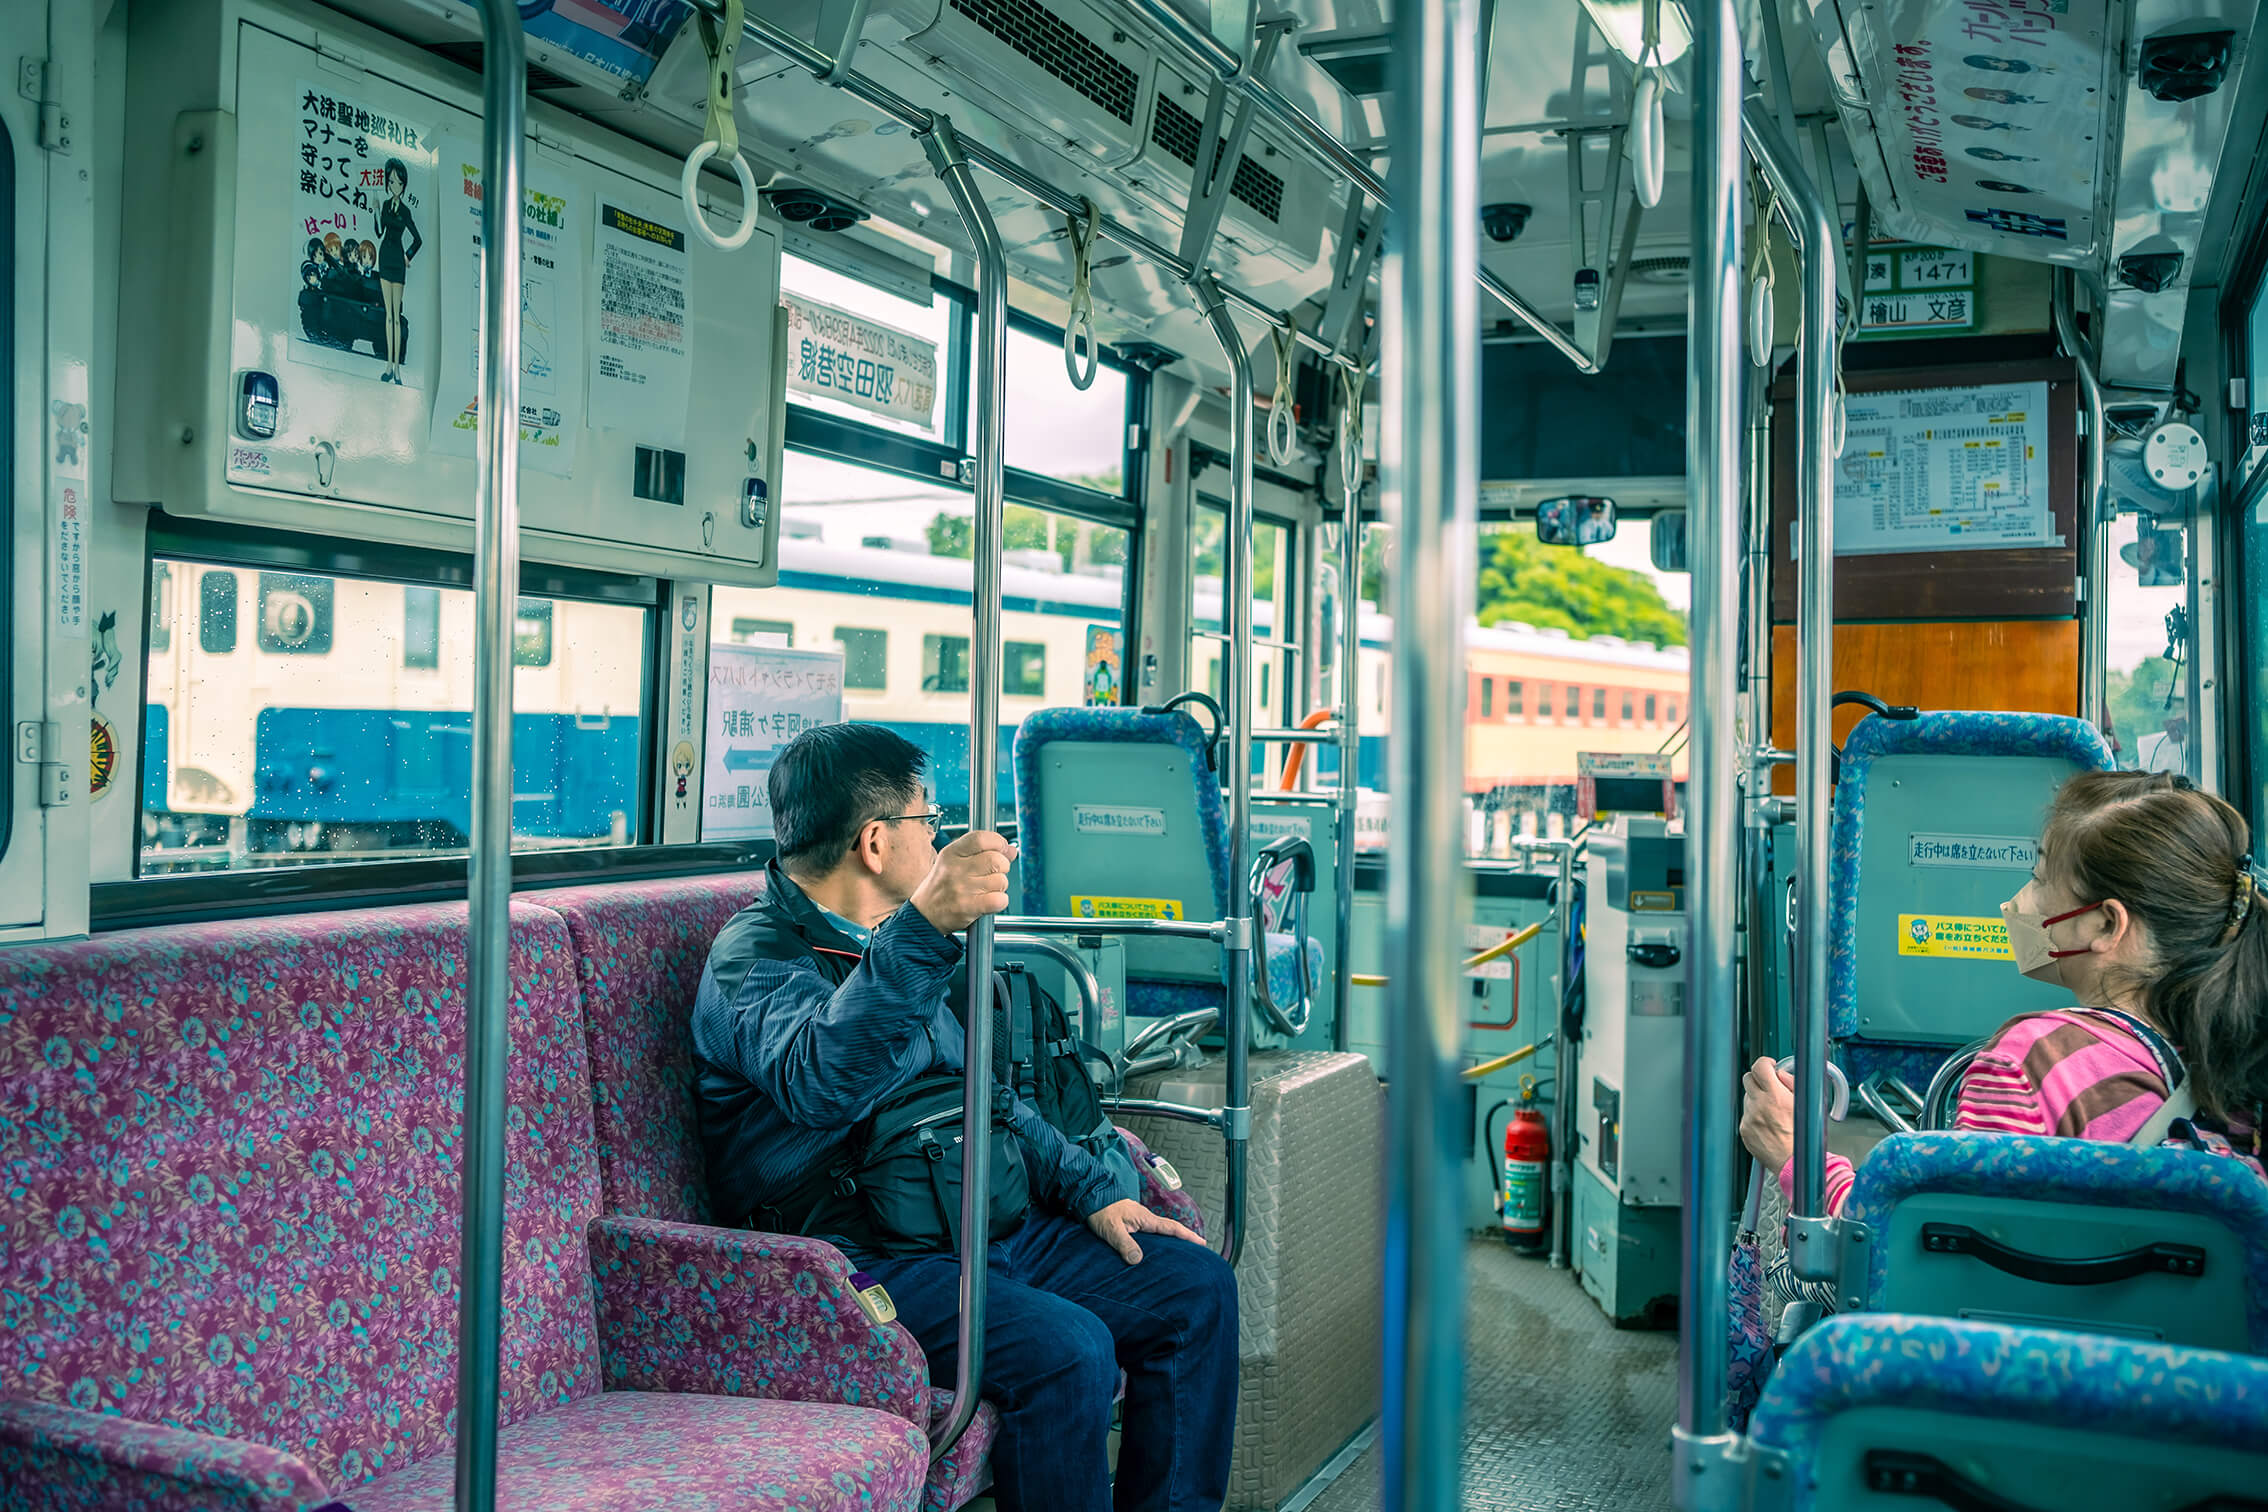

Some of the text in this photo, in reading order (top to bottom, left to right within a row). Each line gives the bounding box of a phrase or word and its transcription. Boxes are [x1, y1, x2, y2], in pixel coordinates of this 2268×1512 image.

[302, 89, 418, 150] 大洗聖地巡礼は
[302, 119, 369, 158] マナーを
[301, 143, 351, 178] 守って
[359, 168, 384, 186] 大洗
[300, 169, 373, 213] 楽しくね。
[1914, 262, 1968, 281] 1471
[1927, 298, 1967, 321] 文彦
[63, 487, 77, 520] 危険
[1913, 842, 2034, 863] 走行中は席を立たないで下さい
